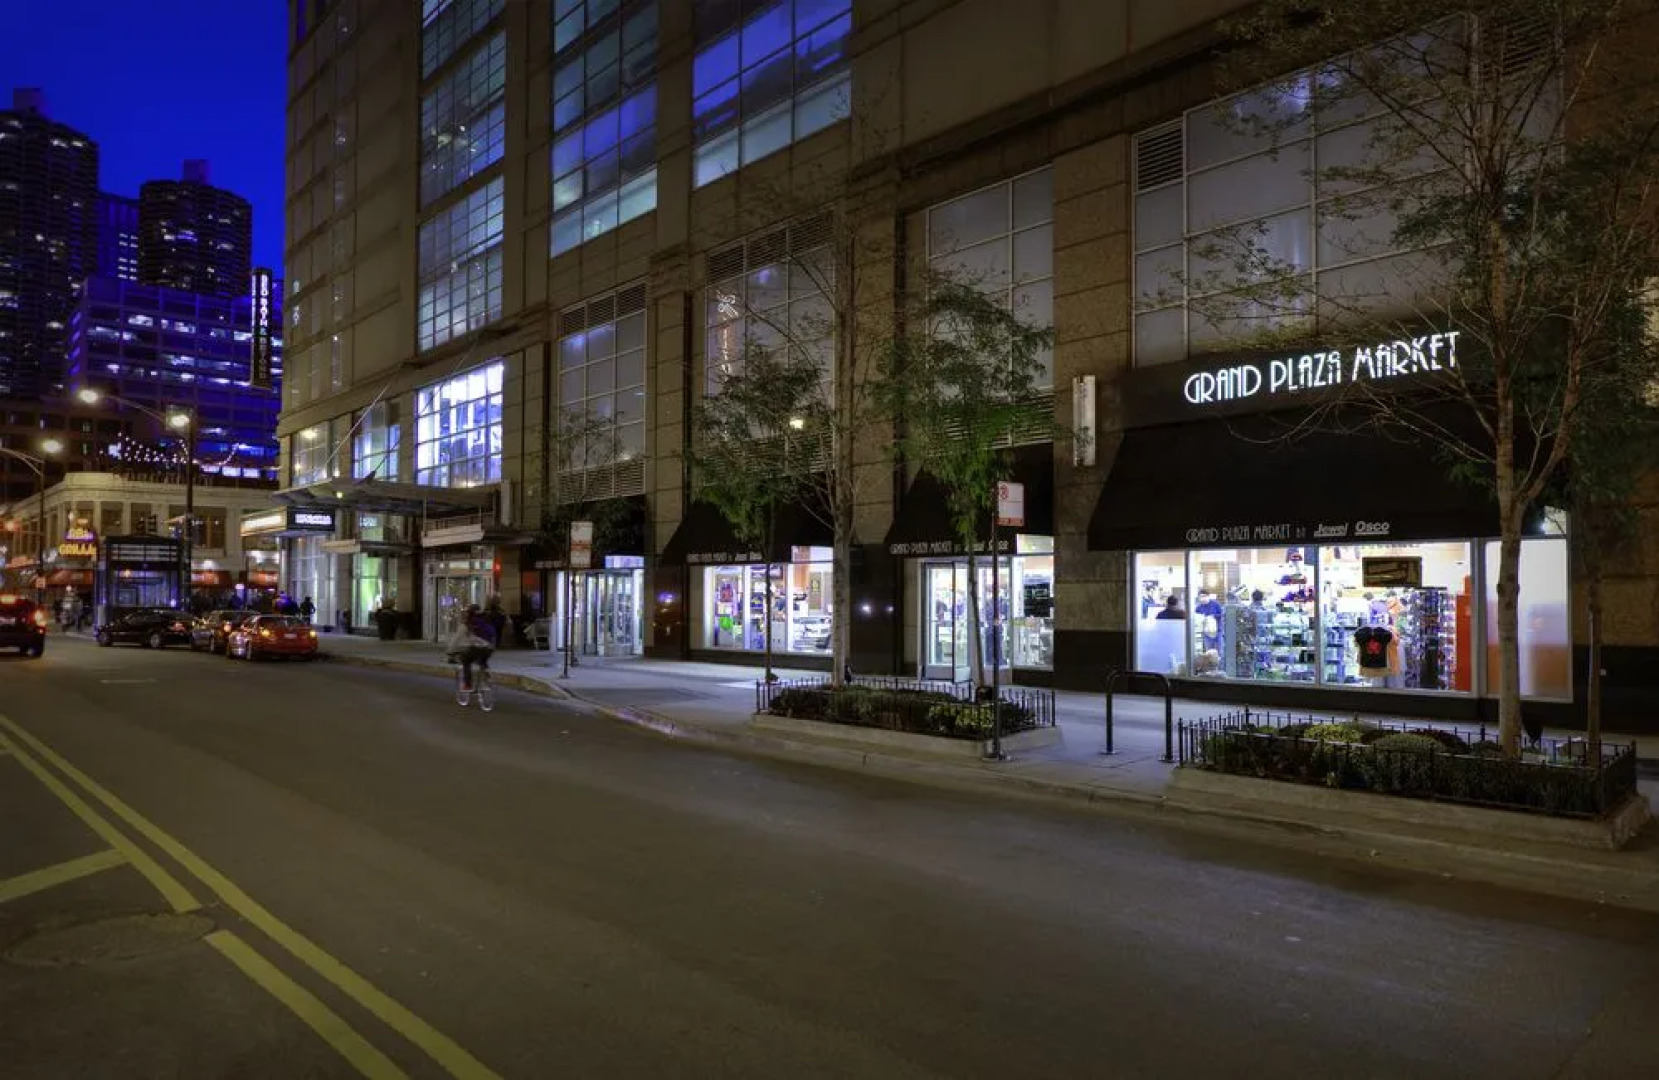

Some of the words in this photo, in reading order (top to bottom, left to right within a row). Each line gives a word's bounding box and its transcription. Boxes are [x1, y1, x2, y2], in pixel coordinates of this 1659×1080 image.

[1184, 365, 1262, 403] GRAND
[1270, 351, 1342, 393] PLAZA
[1352, 331, 1461, 382] MARKET
[1185, 528, 1219, 542] GRAND
[1354, 520, 1390, 534] Osco
